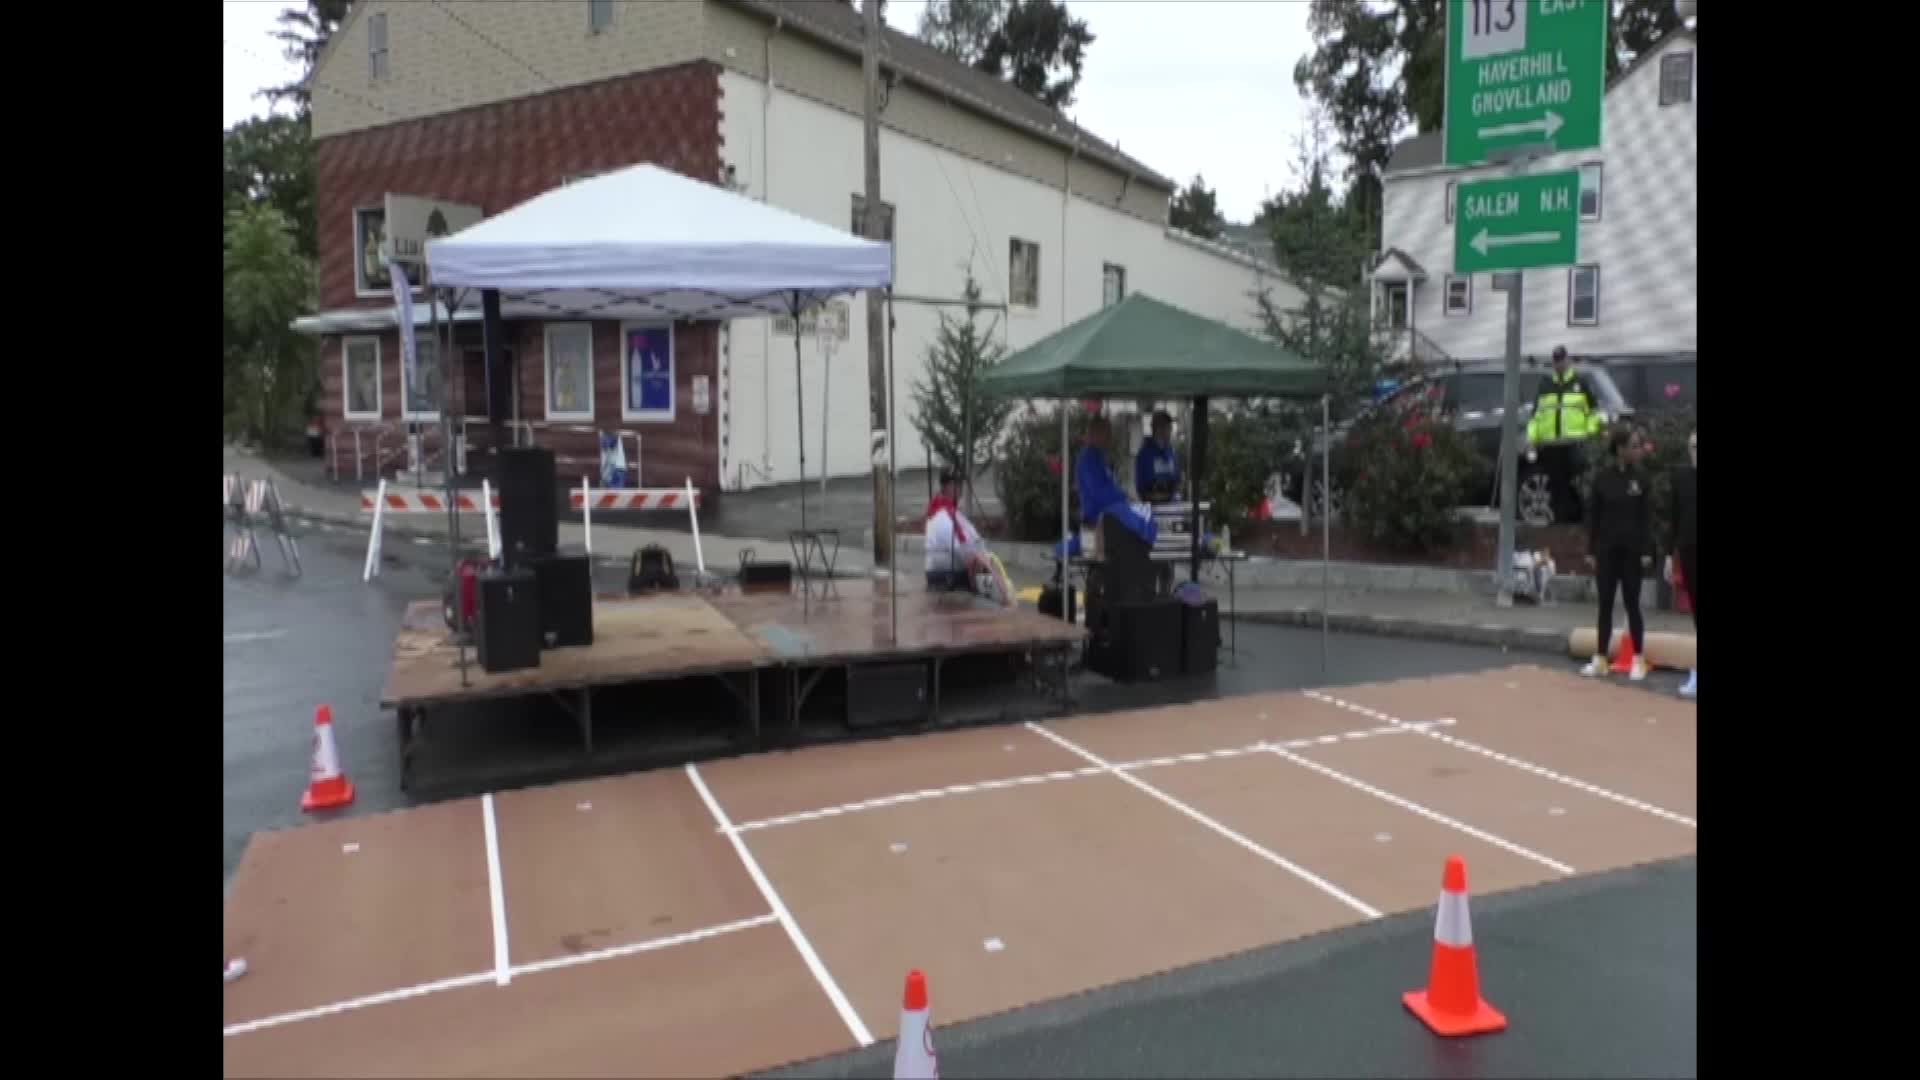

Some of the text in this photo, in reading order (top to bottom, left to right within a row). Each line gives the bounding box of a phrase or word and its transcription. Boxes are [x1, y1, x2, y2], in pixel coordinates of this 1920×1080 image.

[1472, 0, 1515, 35] 113
[1478, 51, 1568, 87] HAVERHILL
[1472, 79, 1572, 117] GROVELAND
[1465, 191, 1520, 220] SALEM
